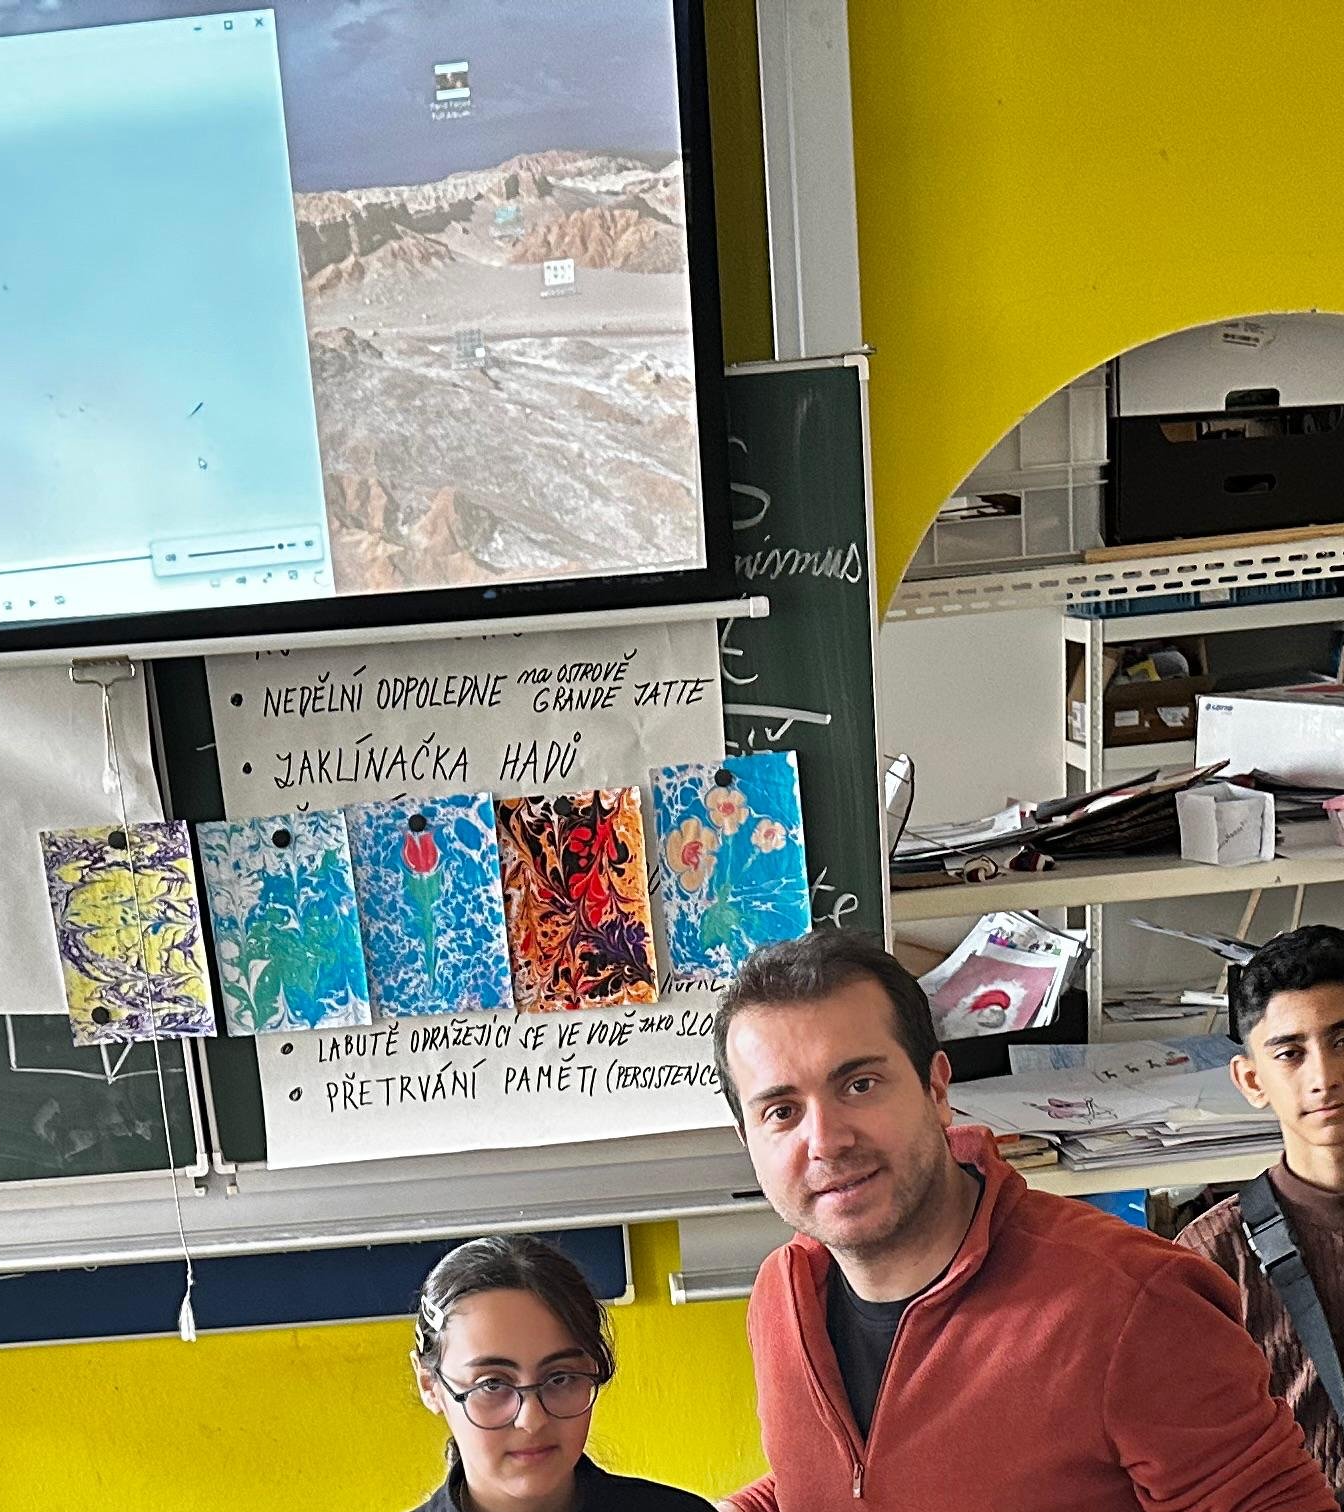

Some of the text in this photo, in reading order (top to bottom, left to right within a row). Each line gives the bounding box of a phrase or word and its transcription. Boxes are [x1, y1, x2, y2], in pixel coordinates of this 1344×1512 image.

[262, 664, 509, 718] NEDĚLNÍ ODPOLEDNE
[556, 648, 637, 684] OSTROVĚ
[532, 676, 716, 714] GRANDE JATTE
[499, 731, 583, 785] HADŮ
[316, 1009, 714, 1064] LABUTĚ ODRÁŽEJÍCÍ SE VE VODĚ JAKO SLO
[326, 1056, 723, 1113] PŘETRVÁNÍ PAMĚTI (PERSISTENCE
